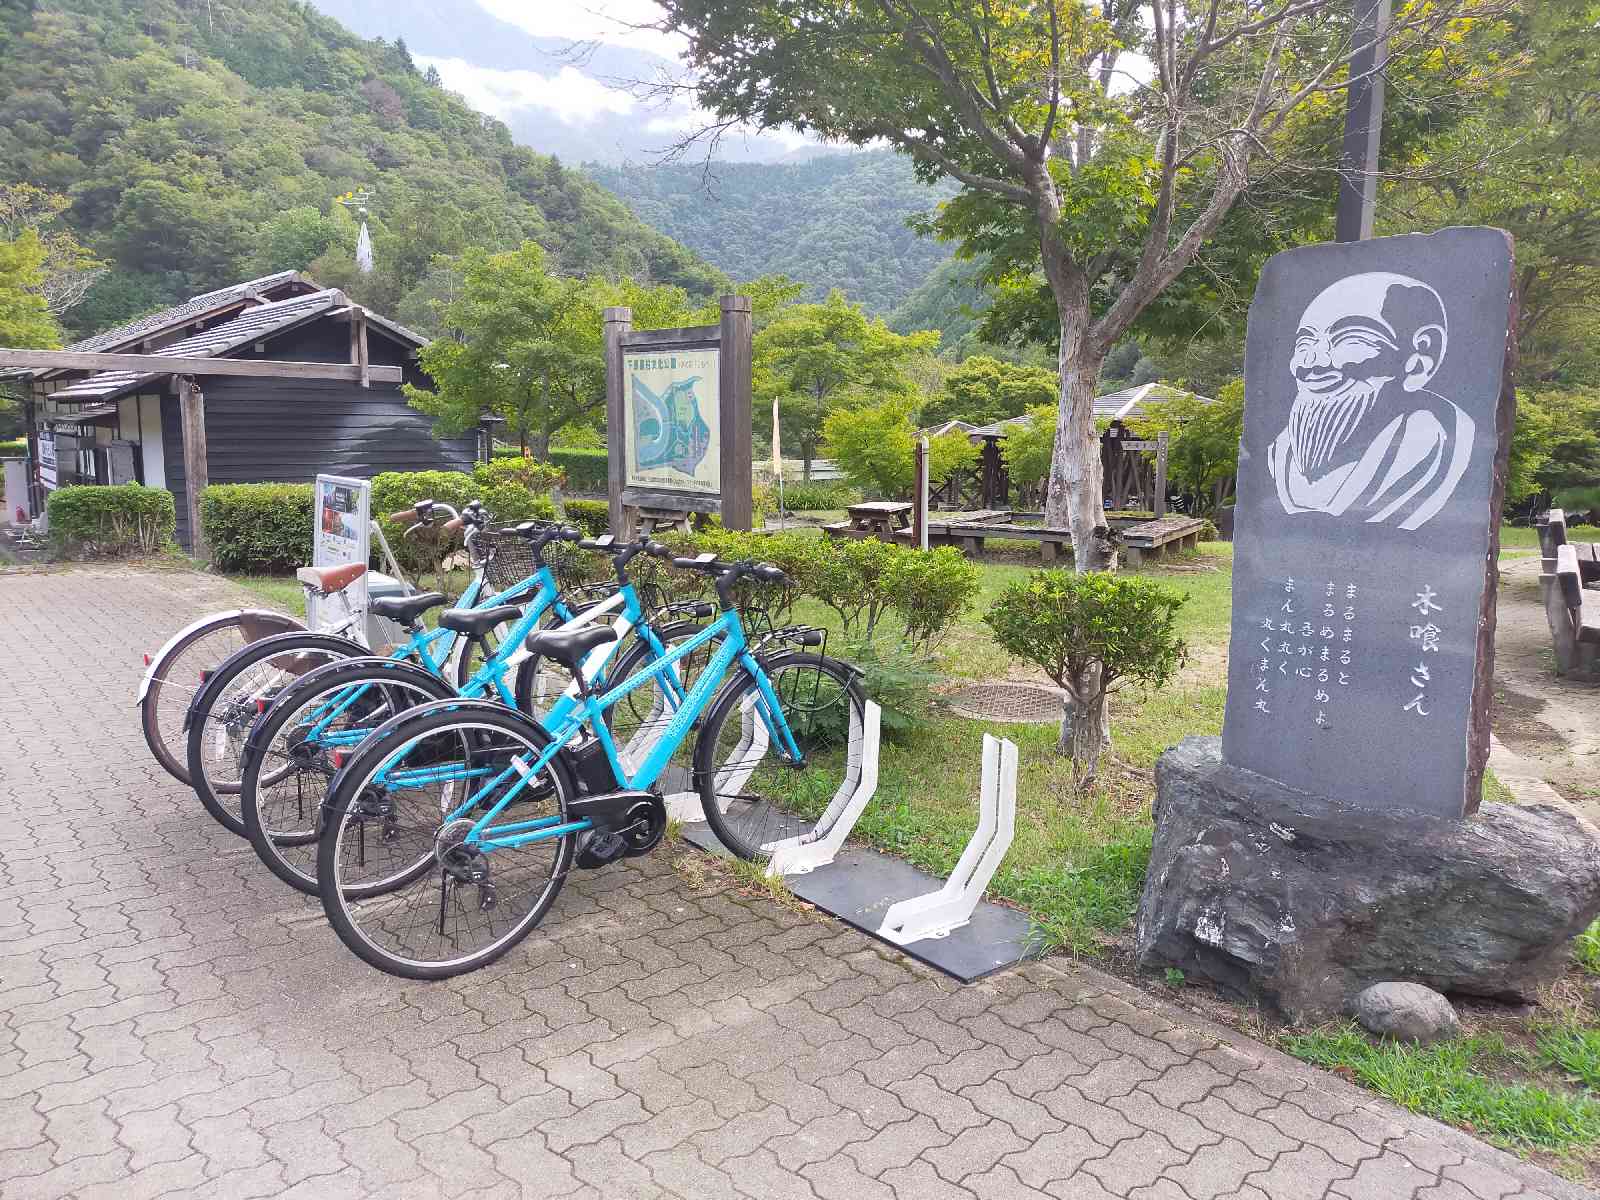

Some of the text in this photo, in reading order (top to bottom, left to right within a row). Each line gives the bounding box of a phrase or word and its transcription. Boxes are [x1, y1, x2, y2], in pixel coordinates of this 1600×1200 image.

[1253, 616, 1276, 713] 丸くまん丸
[1278, 575, 1296, 675] まん丸丸く
[1313, 581, 1336, 725] まるめまるめよ
[1337, 582, 1357, 685] まるまると
[1402, 583, 1443, 716] 木喰さん
